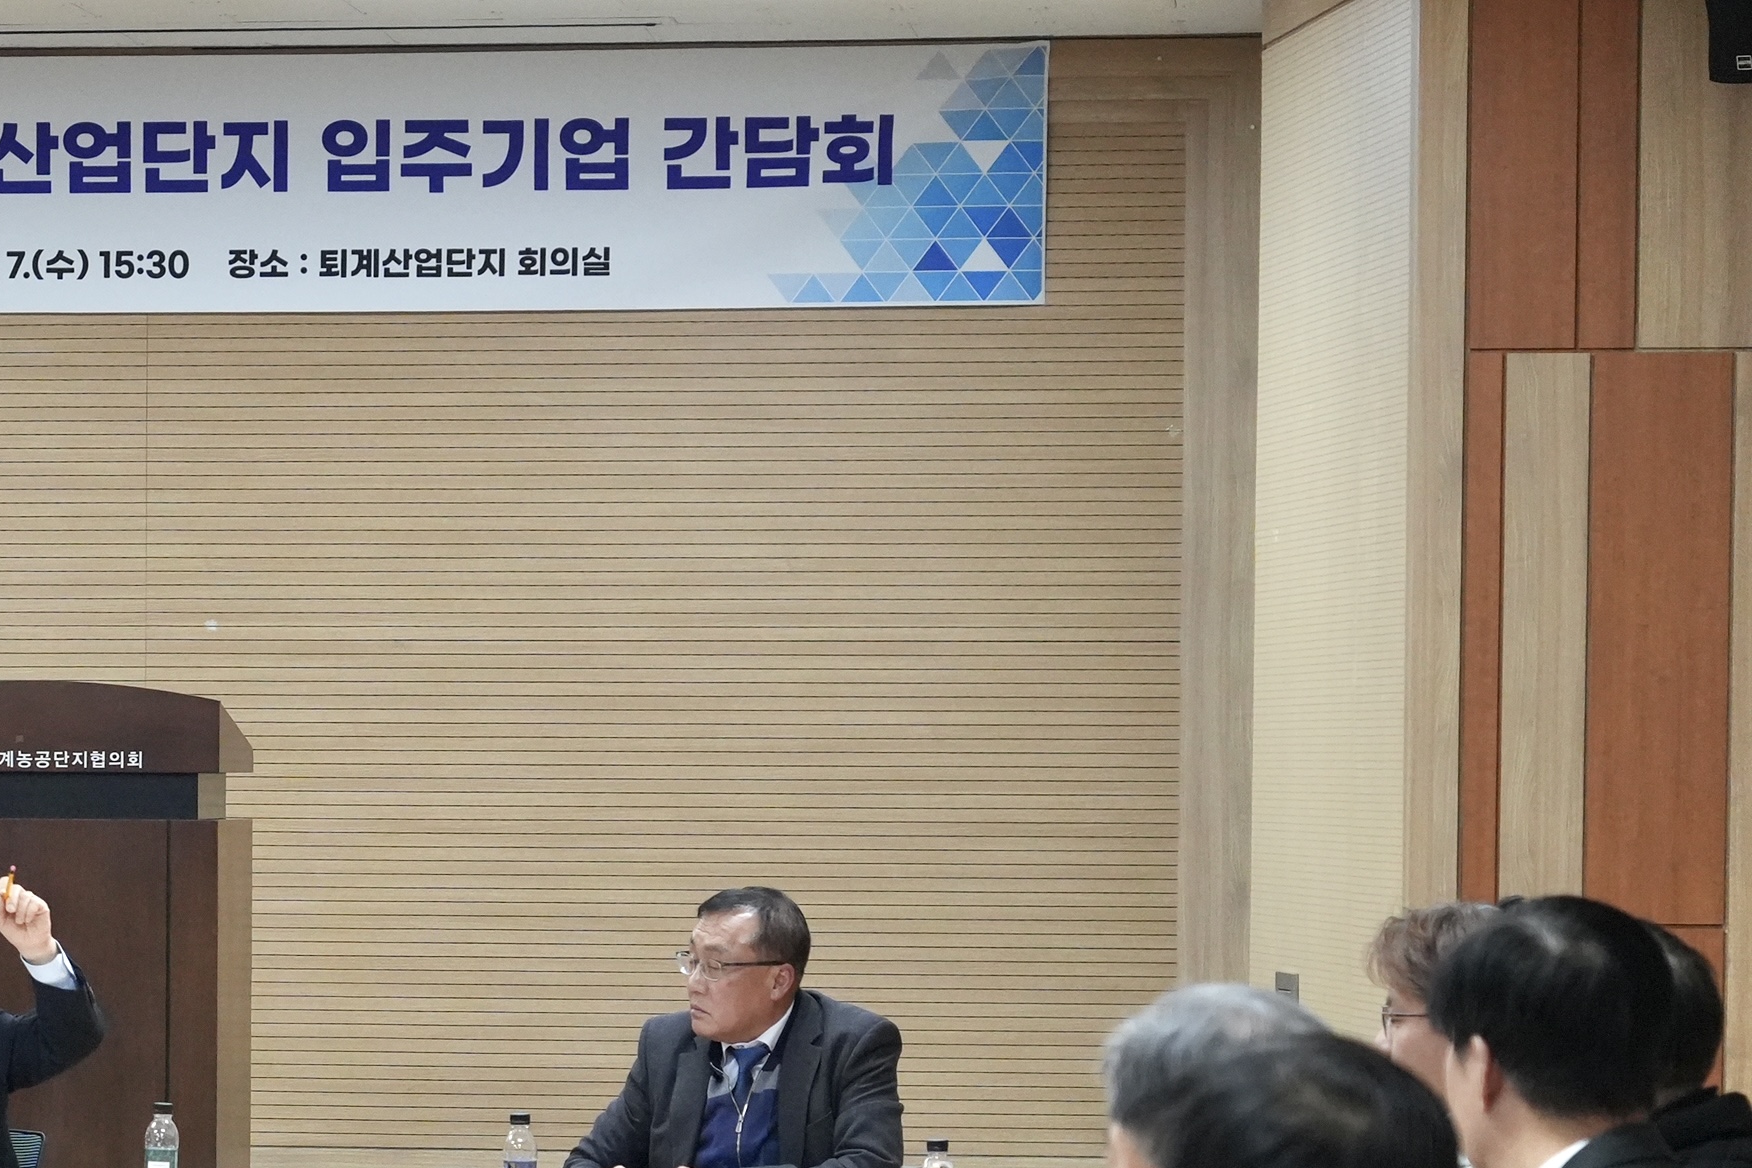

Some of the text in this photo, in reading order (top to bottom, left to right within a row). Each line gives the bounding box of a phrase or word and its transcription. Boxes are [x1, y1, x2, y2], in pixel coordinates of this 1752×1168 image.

[321, 117, 630, 193] 입주기업
[663, 114, 896, 190] 간담회
[99, 249, 190, 279] 15:30
[228, 249, 289, 279] 장소
[318, 247, 506, 278] 퇴계산업단지
[517, 246, 610, 277] 회의실
